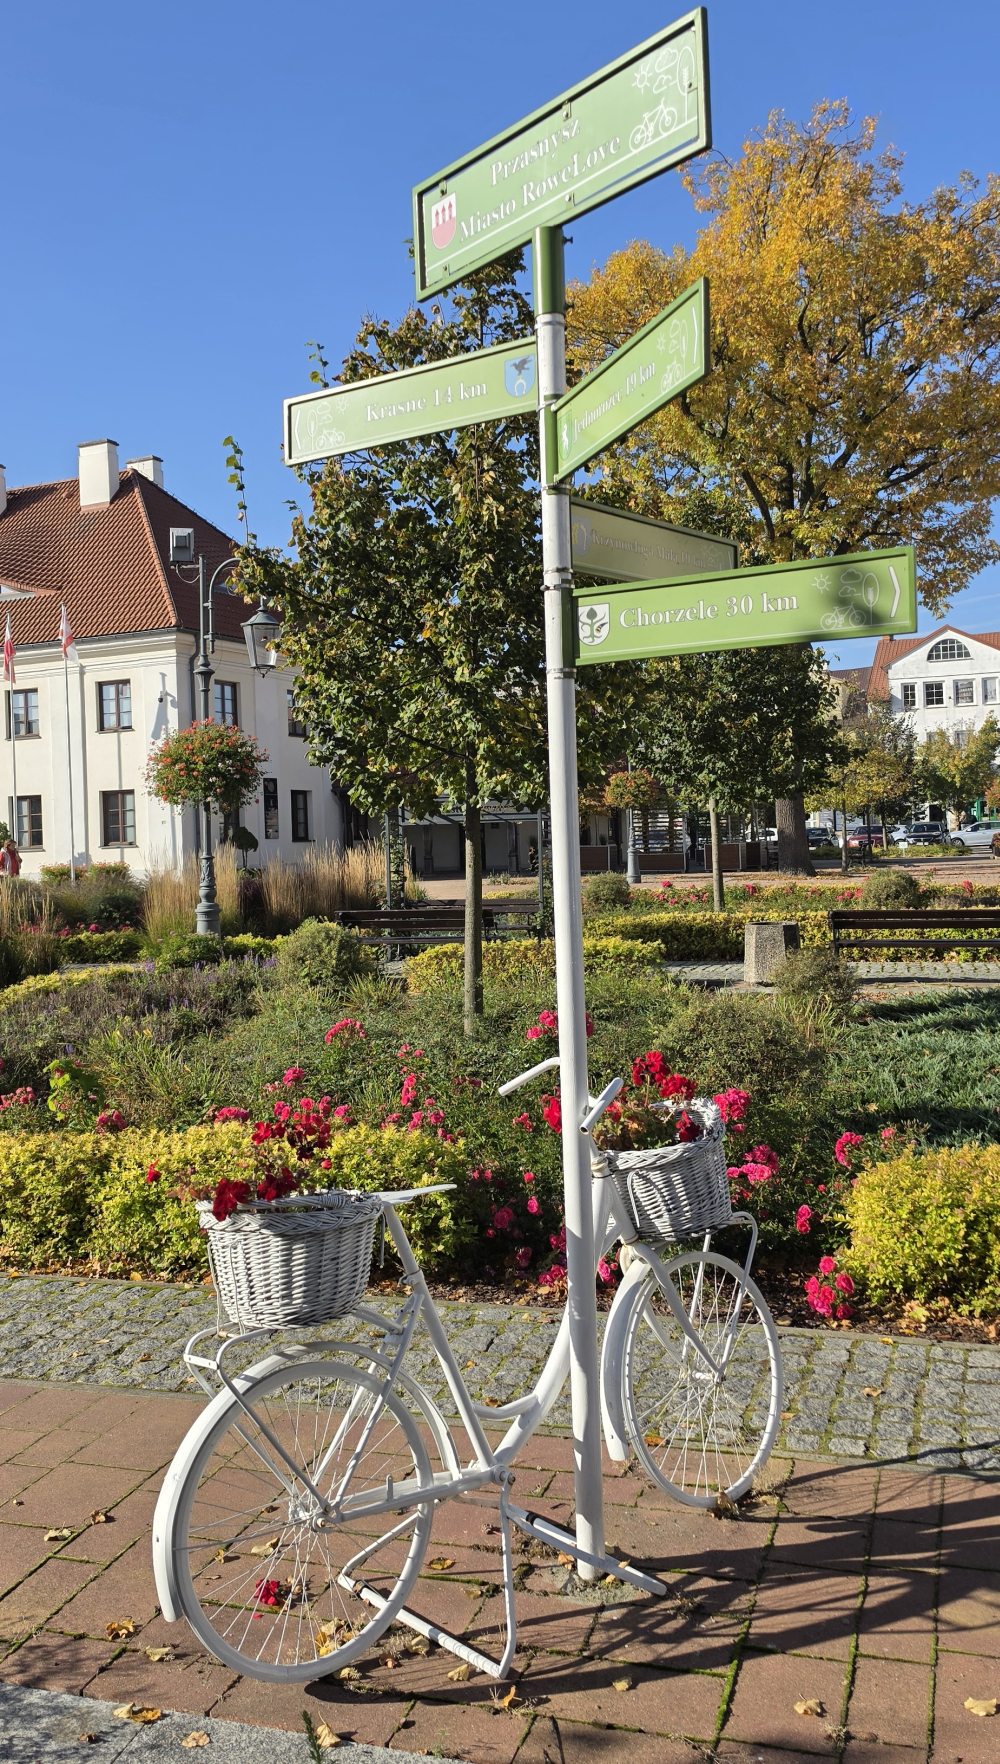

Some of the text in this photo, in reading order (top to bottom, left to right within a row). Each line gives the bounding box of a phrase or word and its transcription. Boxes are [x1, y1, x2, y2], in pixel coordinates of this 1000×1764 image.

[490, 118, 581, 187] Przasnysz
[459, 137, 620, 242] Miasto RoweLove
[639, 362, 656, 385] km
[366, 381, 488, 422] Krasne 14 km
[618, 591, 800, 629] Chorzele 30 km
